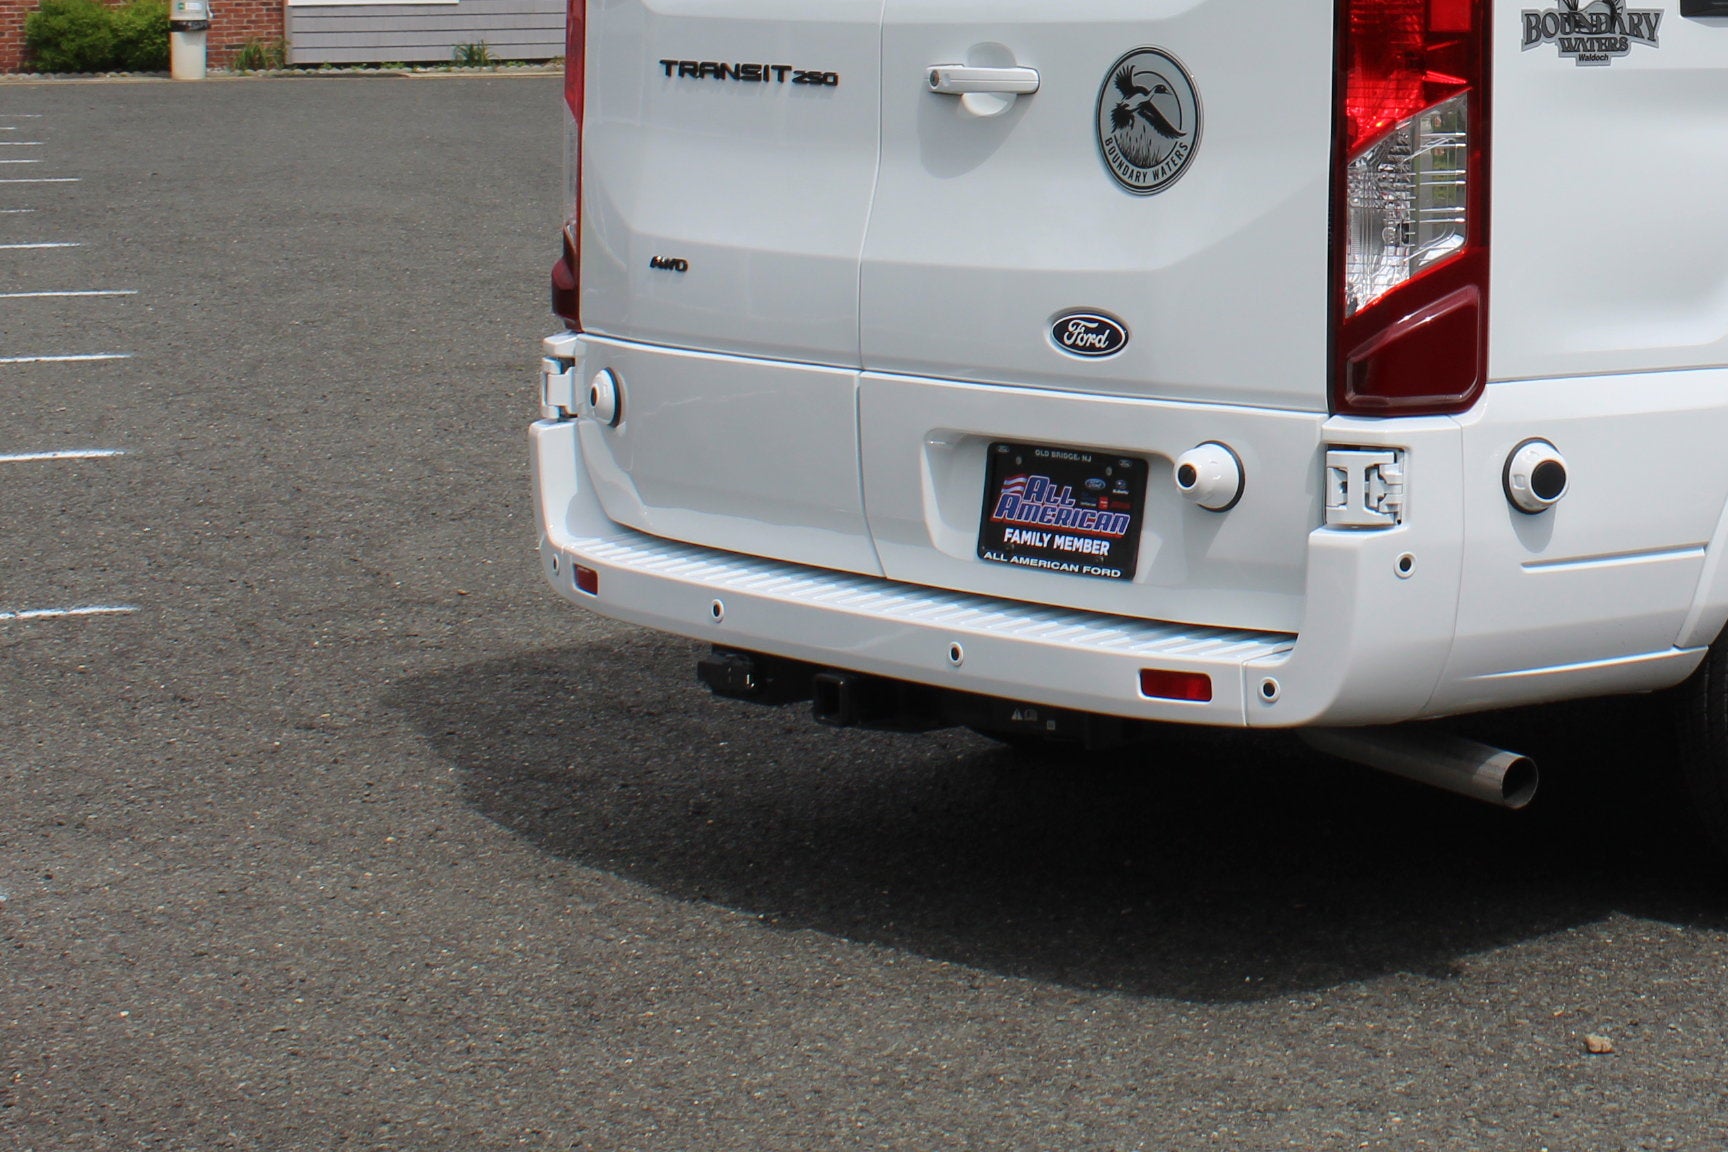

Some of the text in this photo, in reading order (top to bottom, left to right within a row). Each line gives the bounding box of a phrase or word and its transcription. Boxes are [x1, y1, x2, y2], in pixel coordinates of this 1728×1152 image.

[1524, 12, 1661, 46] BOUNDARY
[1558, 36, 1629, 53] WATERS
[1578, 53, 1609, 62] Waldoch
[659, 59, 839, 87] TRANSIT 250
[1104, 136, 1189, 184] BOUNDARY WATERS
[1063, 319, 1110, 348] Ford
[1034, 449, 1050, 458] OLD
[1082, 455, 1092, 463] NJ
[1022, 475, 1076, 508] ALL
[993, 492, 1131, 535] AMERICAN
[1003, 528, 1110, 556] FAMILY MEMBER
[983, 551, 1121, 578] ALL AMERICAN FORD
